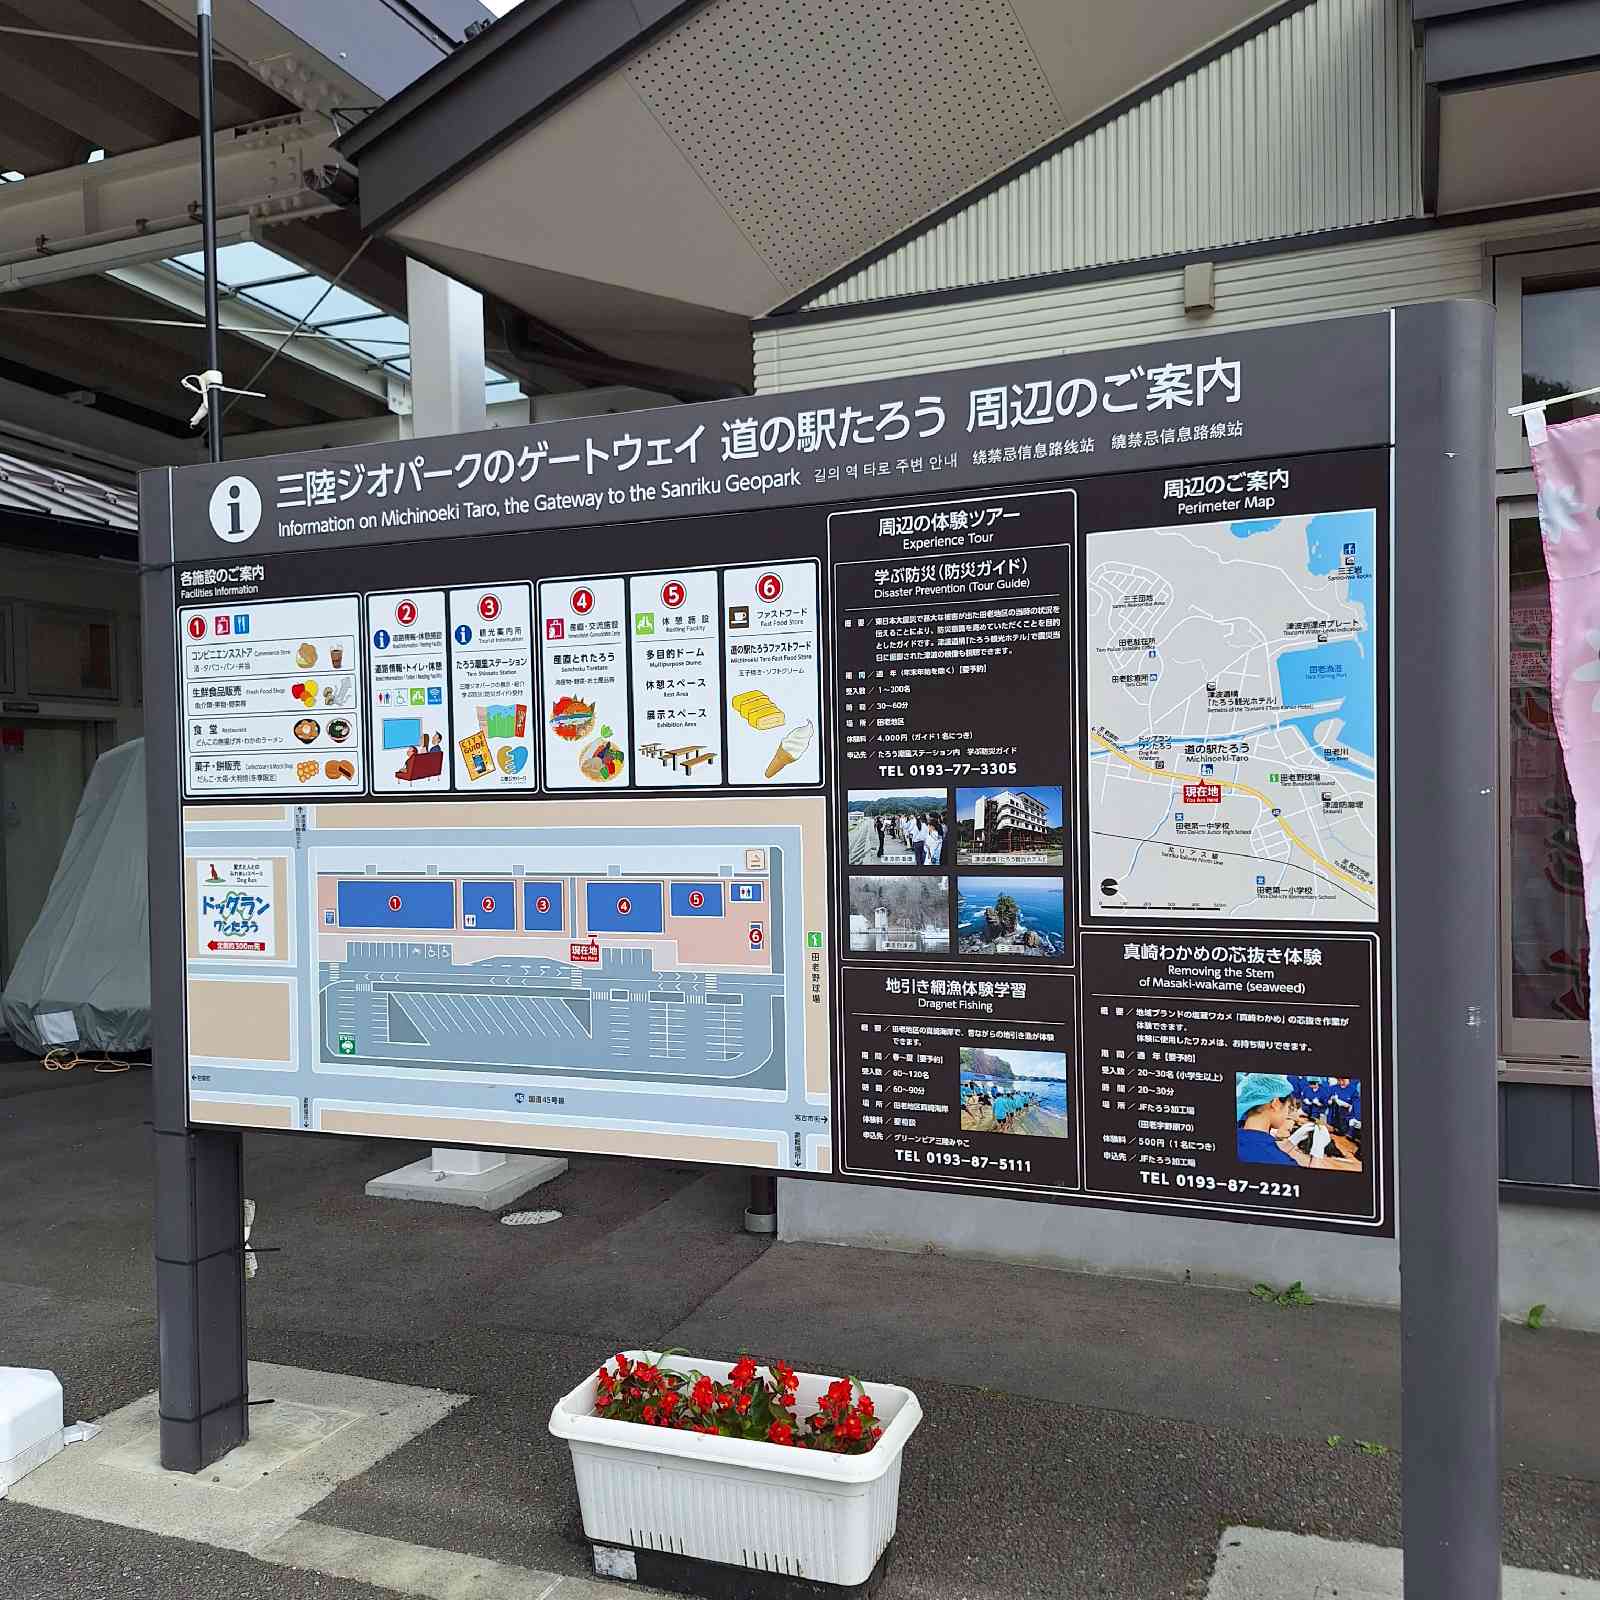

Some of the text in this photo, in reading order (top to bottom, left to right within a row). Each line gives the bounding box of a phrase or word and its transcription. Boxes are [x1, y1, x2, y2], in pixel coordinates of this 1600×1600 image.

[276, 356, 1242, 508] 三陸ジオパークのゲートウェイ 道の駅たろう 周辺のご案内
[814, 453, 958, 484] 길의 역 타로 주변 안내
[1163, 469, 1290, 500] 周辺のご案内
[278, 468, 802, 537] Information on Michinoeki Taro, the Gateway to the Sanriku Geopark
[1178, 495, 1276, 515] Perimeter Map
[878, 507, 1021, 537] 周辺の体験ツアー
[903, 532, 994, 552] Experience Tour
[180, 565, 265, 588] 各施設のご案内
[181, 584, 259, 600] Facilities Information
[874, 578, 1031, 599] Disaster Prevention (Tour Guide)
[757, 608, 808, 619] ファストフード
[192, 648, 253, 661] コンビニエンスストア
[646, 648, 705, 661] 多目的ドーム
[730, 641, 813, 656] 道の駅たろうファストフード
[553, 652, 615, 665] 産直とれたろう
[192, 685, 242, 698] 生鮮食品販売
[646, 678, 707, 691] 休憩スペース
[646, 708, 708, 721] 展示スペース
[1184, 743, 1251, 755] 道の駅たろう
[879, 765, 904, 777] TEL
[1185, 786, 1220, 799] 現在地
[203, 895, 271, 916] ドッグラン
[213, 920, 259, 933] ワンたろう
[572, 945, 598, 956] 現在地
[1123, 943, 1324, 967] 真崎わかめの芯抜き体験
[1168, 965, 1276, 981] Removing the Stem
[885, 977, 1028, 999] 地引き網漁体験学習
[1139, 976, 1307, 995] of Masaki-wakame (seaweed)
[918, 998, 994, 1014] Dragnet Fishing
[895, 1150, 921, 1164] TEL
[1140, 1170, 1170, 1185] TEL
